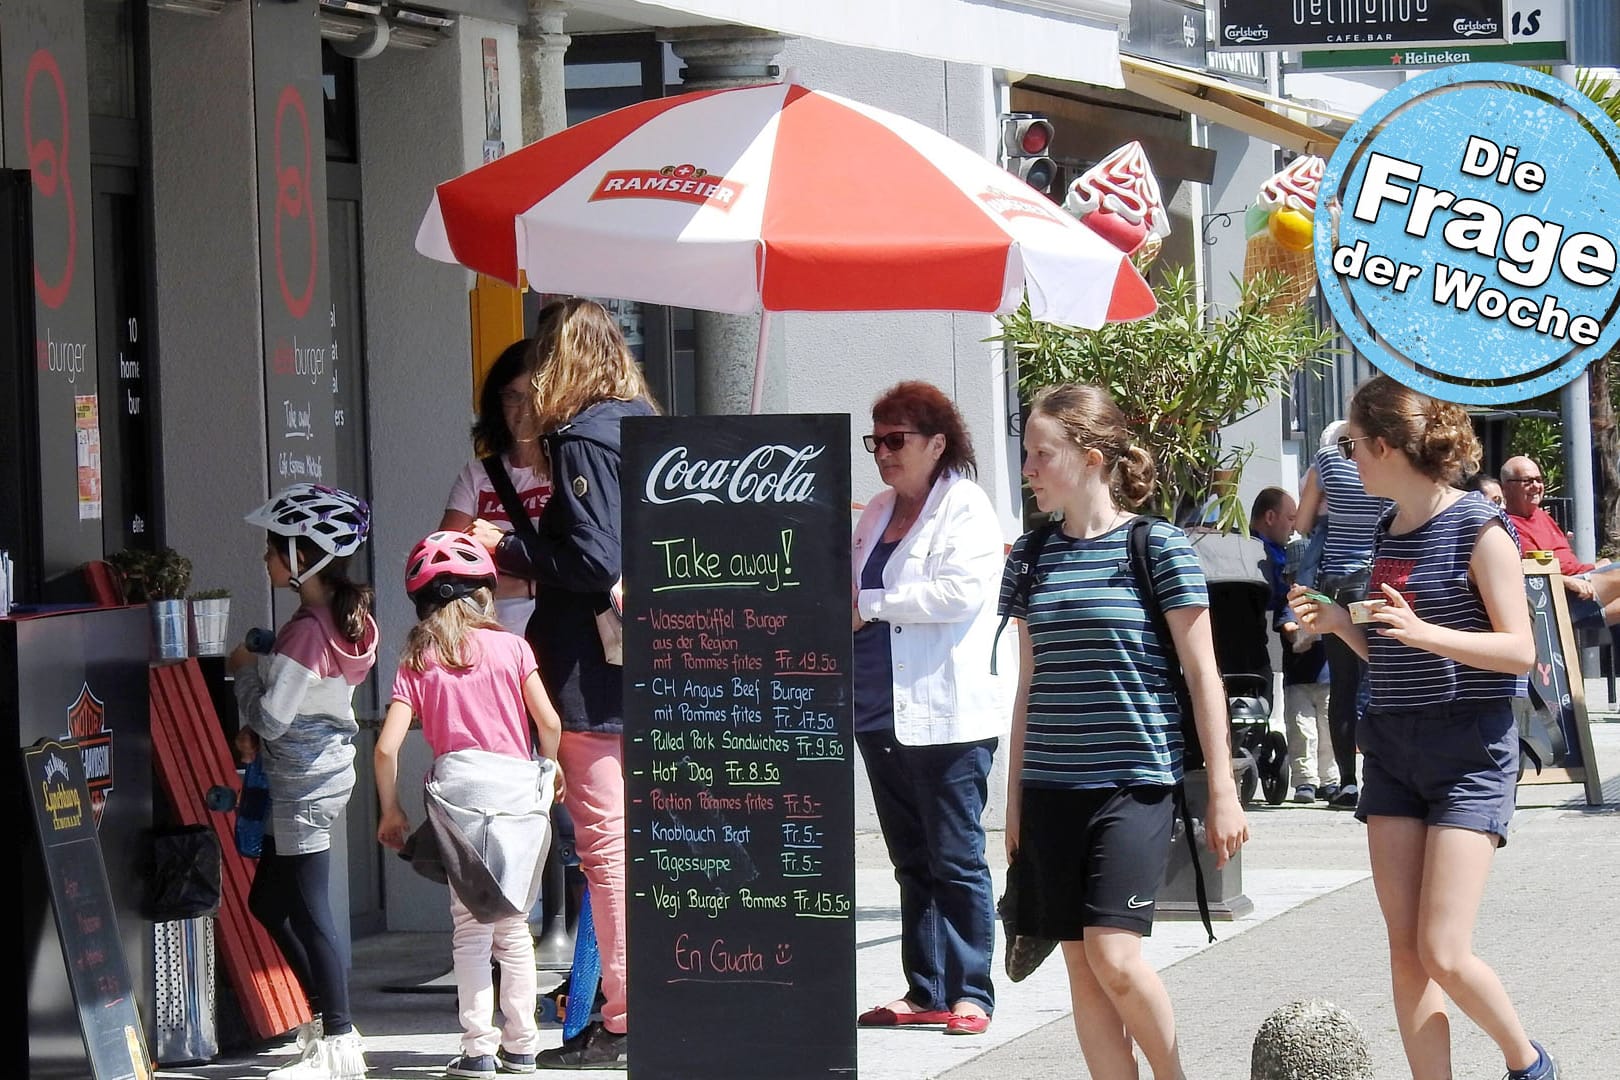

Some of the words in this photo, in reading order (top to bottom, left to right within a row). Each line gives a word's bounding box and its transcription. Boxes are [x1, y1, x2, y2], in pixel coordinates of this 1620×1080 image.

[1225, 24, 1268, 43] Carlsberg
[1453, 18, 1497, 36] Carlsberg
[1405, 51, 1471, 65] Heineken
[604, 177, 735, 203] RAMSEIER
[641, 445, 826, 504] Coca-Cola
[652, 538, 722, 579] Take
[730, 529, 793, 592] away!
[651, 607, 736, 637] Wasserbüffel
[744, 609, 788, 634] Burger
[653, 639, 673, 650] aus
[676, 635, 694, 649] der
[699, 632, 738, 655] Region
[681, 652, 729, 669] Pommes
[731, 652, 762, 673] frites
[652, 678, 677, 697] CH
[683, 679, 725, 708] Angus
[731, 676, 760, 704] Beef
[771, 680, 815, 710] Burger
[653, 704, 673, 721] mit
[678, 703, 727, 722] Pommes
[731, 704, 762, 727] frites
[651, 729, 685, 751] Pulled
[690, 730, 715, 750] Pork
[721, 732, 790, 753] Sandwiches
[652, 759, 678, 782] Hot
[687, 762, 713, 788] Dog
[650, 788, 692, 810] Portion
[697, 791, 742, 810] Pommes
[746, 793, 775, 814] frites
[651, 821, 716, 842] Knoblauch
[722, 824, 751, 843] Brot
[650, 849, 732, 882] Tagessuppe
[652, 884, 681, 918] Vegi
[687, 889, 731, 919] Burger
[739, 888, 787, 909] Pommes
[675, 934, 702, 973] En
